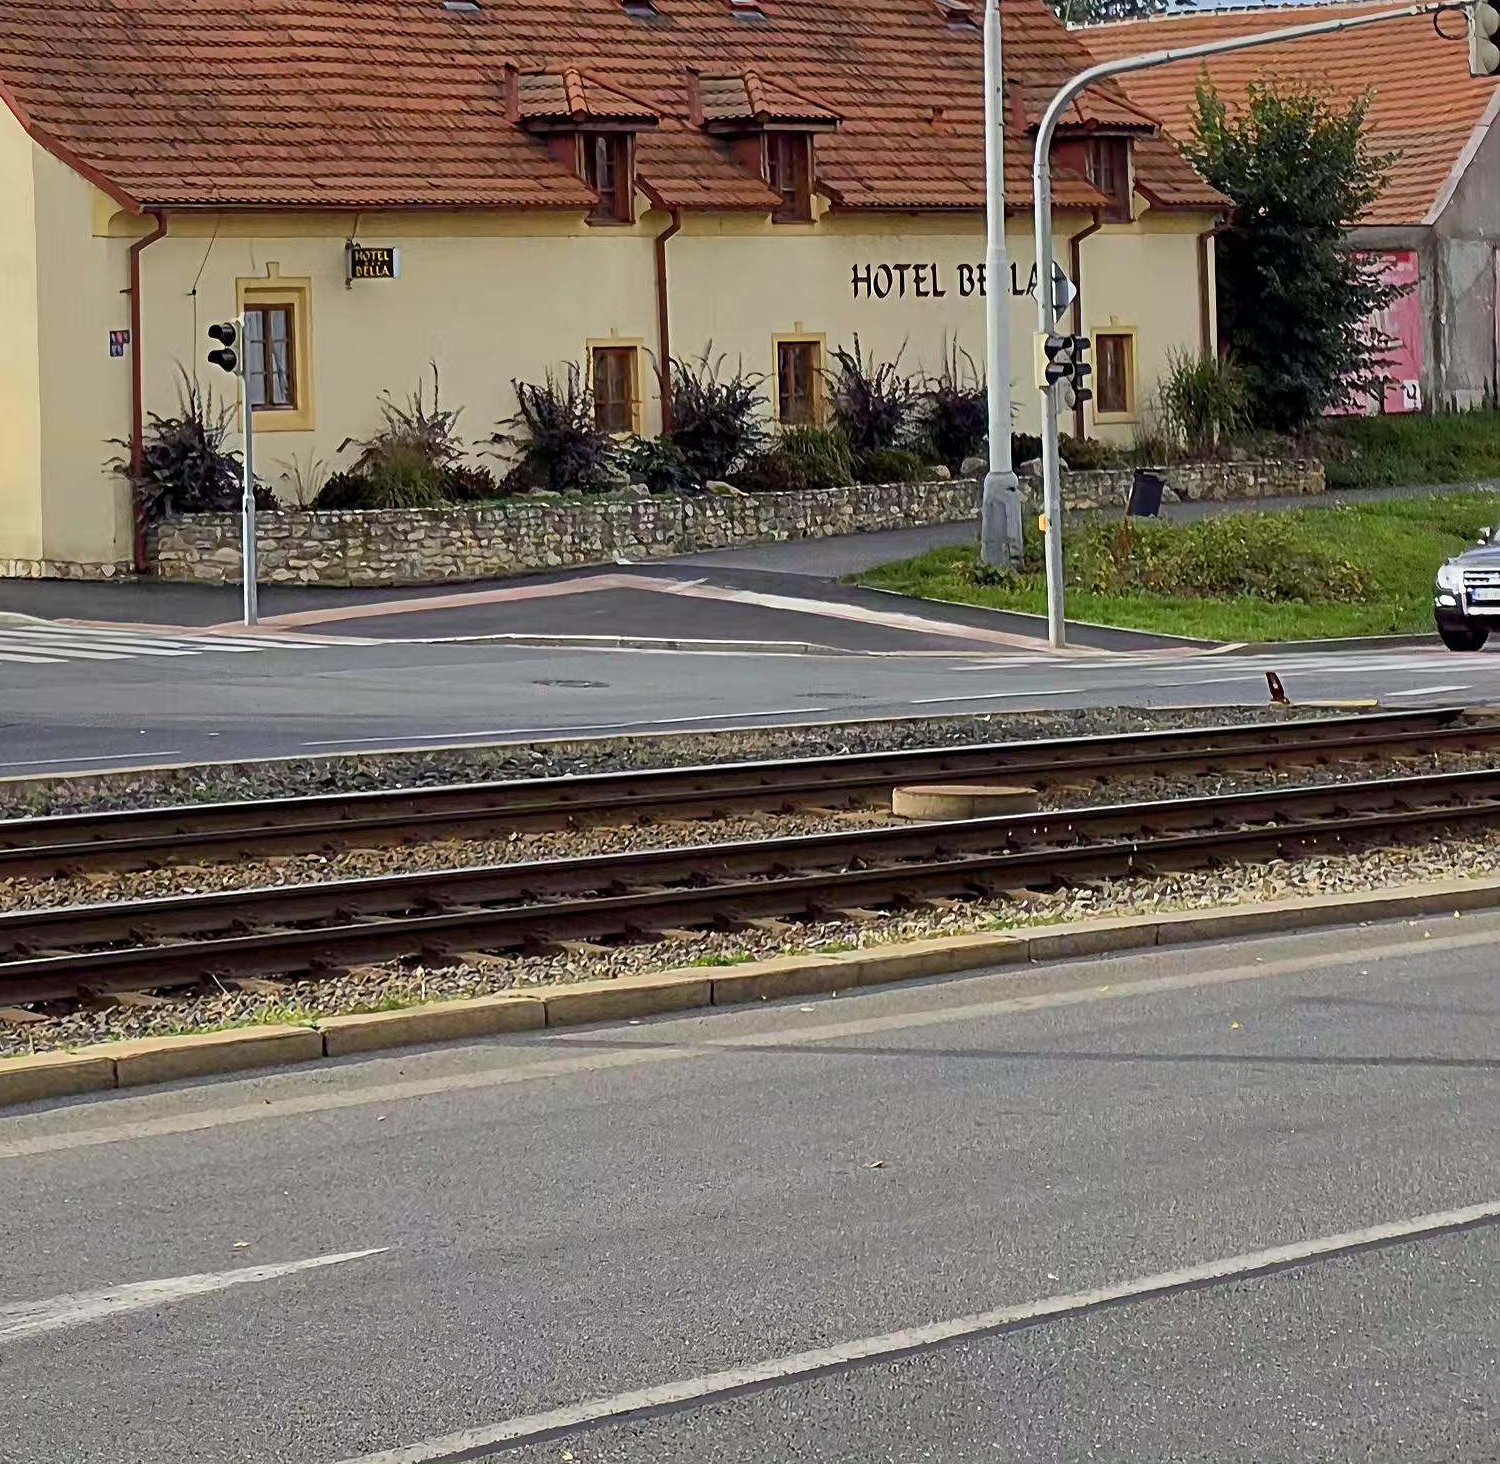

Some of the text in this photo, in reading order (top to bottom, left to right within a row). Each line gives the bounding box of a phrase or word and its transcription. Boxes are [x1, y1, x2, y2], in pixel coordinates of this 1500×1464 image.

[355, 250, 389, 261] HOTEL
[851, 261, 1038, 299] HOTEL BELA
